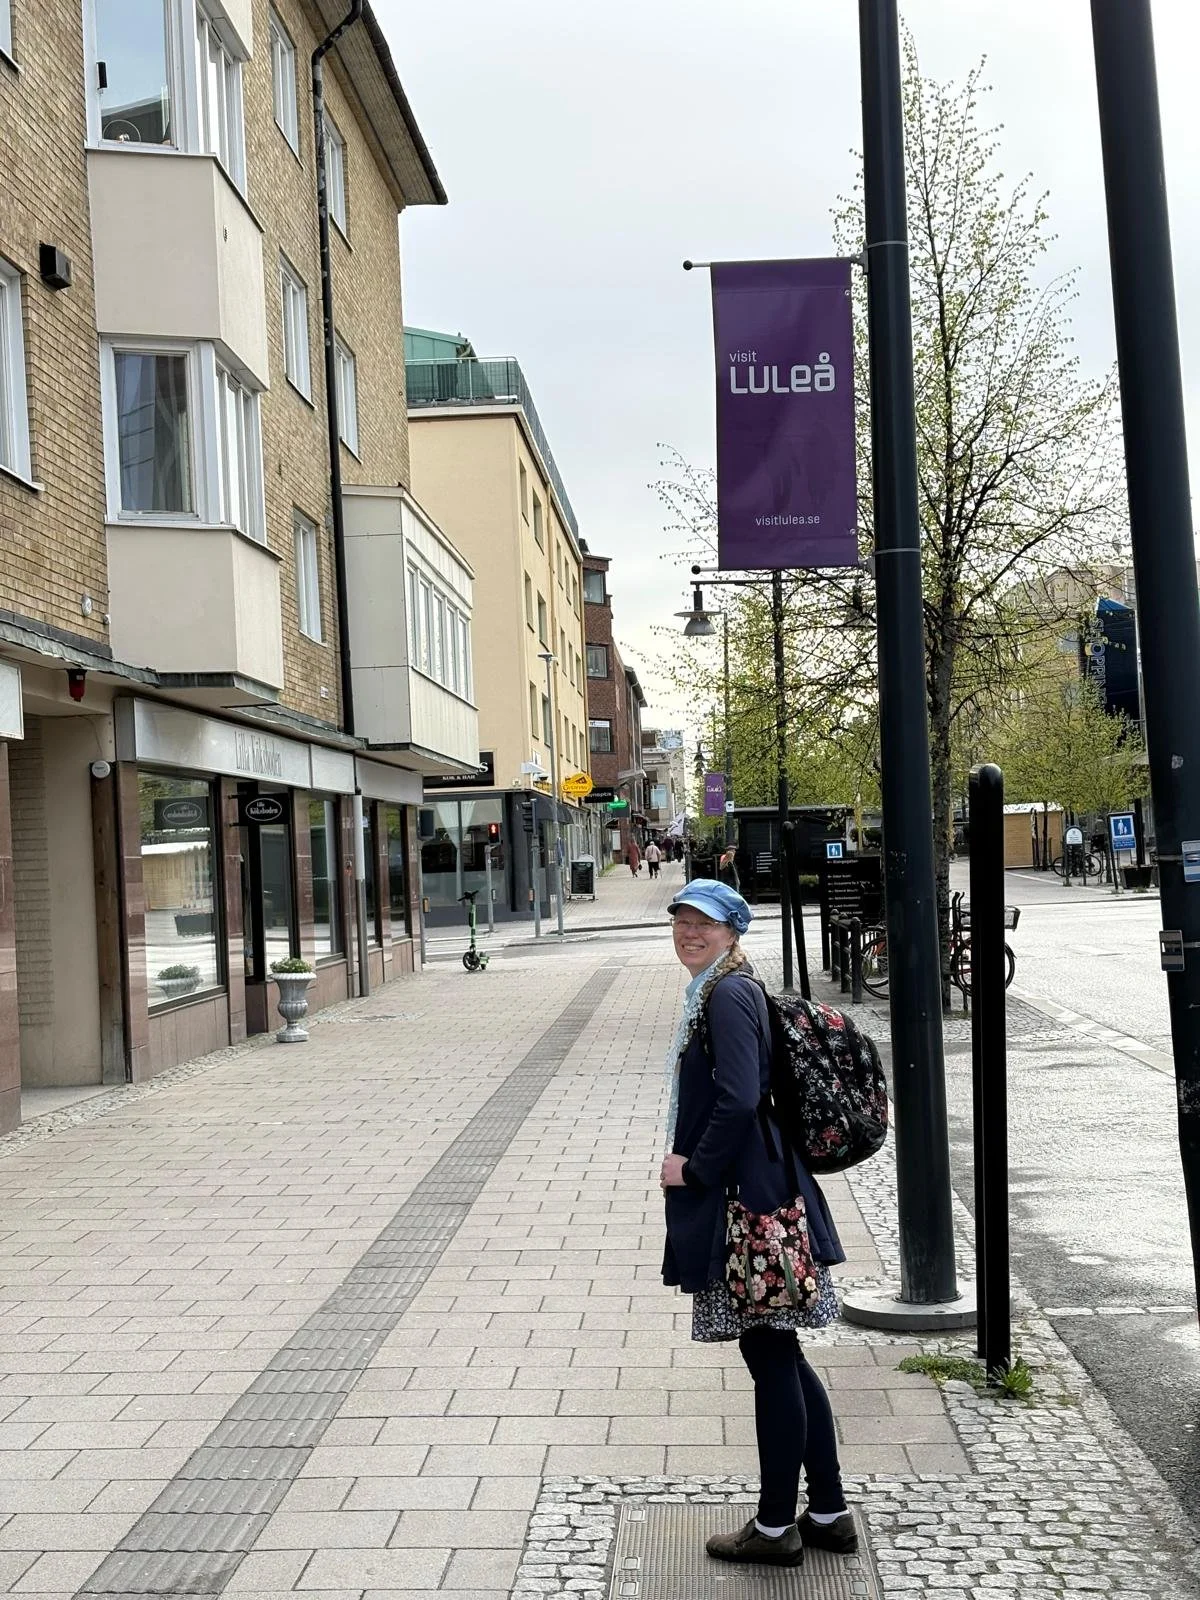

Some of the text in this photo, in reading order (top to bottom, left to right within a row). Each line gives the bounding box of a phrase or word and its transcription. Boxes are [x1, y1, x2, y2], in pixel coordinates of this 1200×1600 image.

[729, 350, 757, 363] visit
[755, 514, 820, 526] visitlulea.se
[234, 730, 251, 771] Lilla
[249, 806, 279, 815] Köksboden
